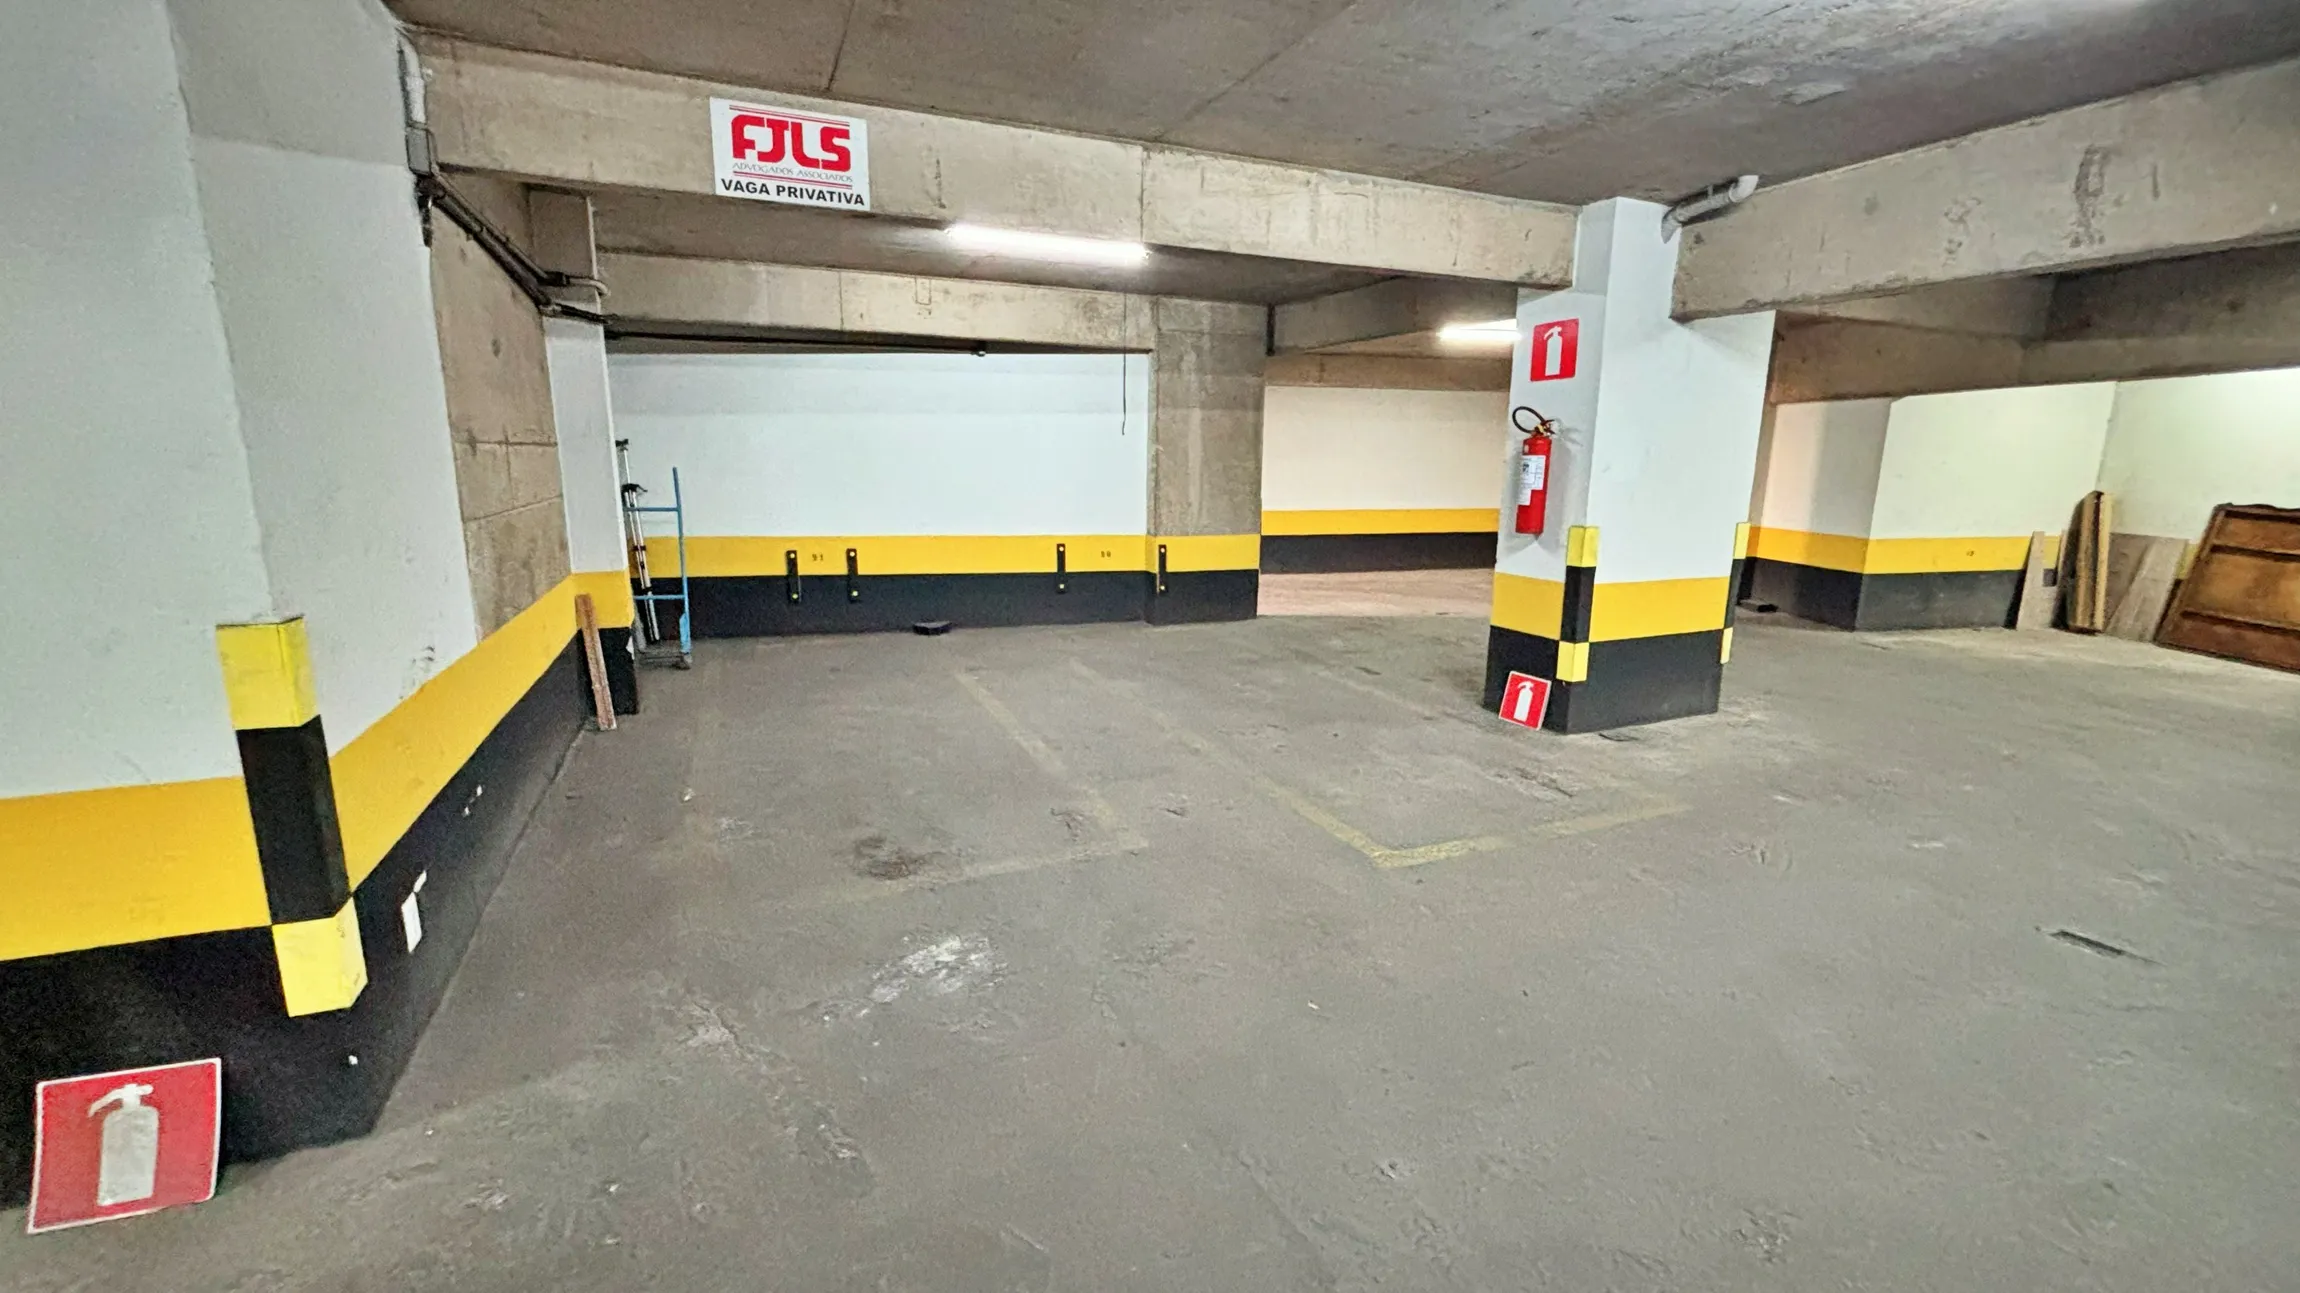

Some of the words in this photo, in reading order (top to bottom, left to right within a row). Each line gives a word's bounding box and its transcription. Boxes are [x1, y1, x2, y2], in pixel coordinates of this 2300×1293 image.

[731, 114, 851, 172] FJLS
[732, 162, 794, 176] ADVOGADOS
[797, 170, 853, 182] ASSOCIADOS
[721, 178, 770, 196] VAGA
[776, 184, 865, 206] PRIVATIVA
